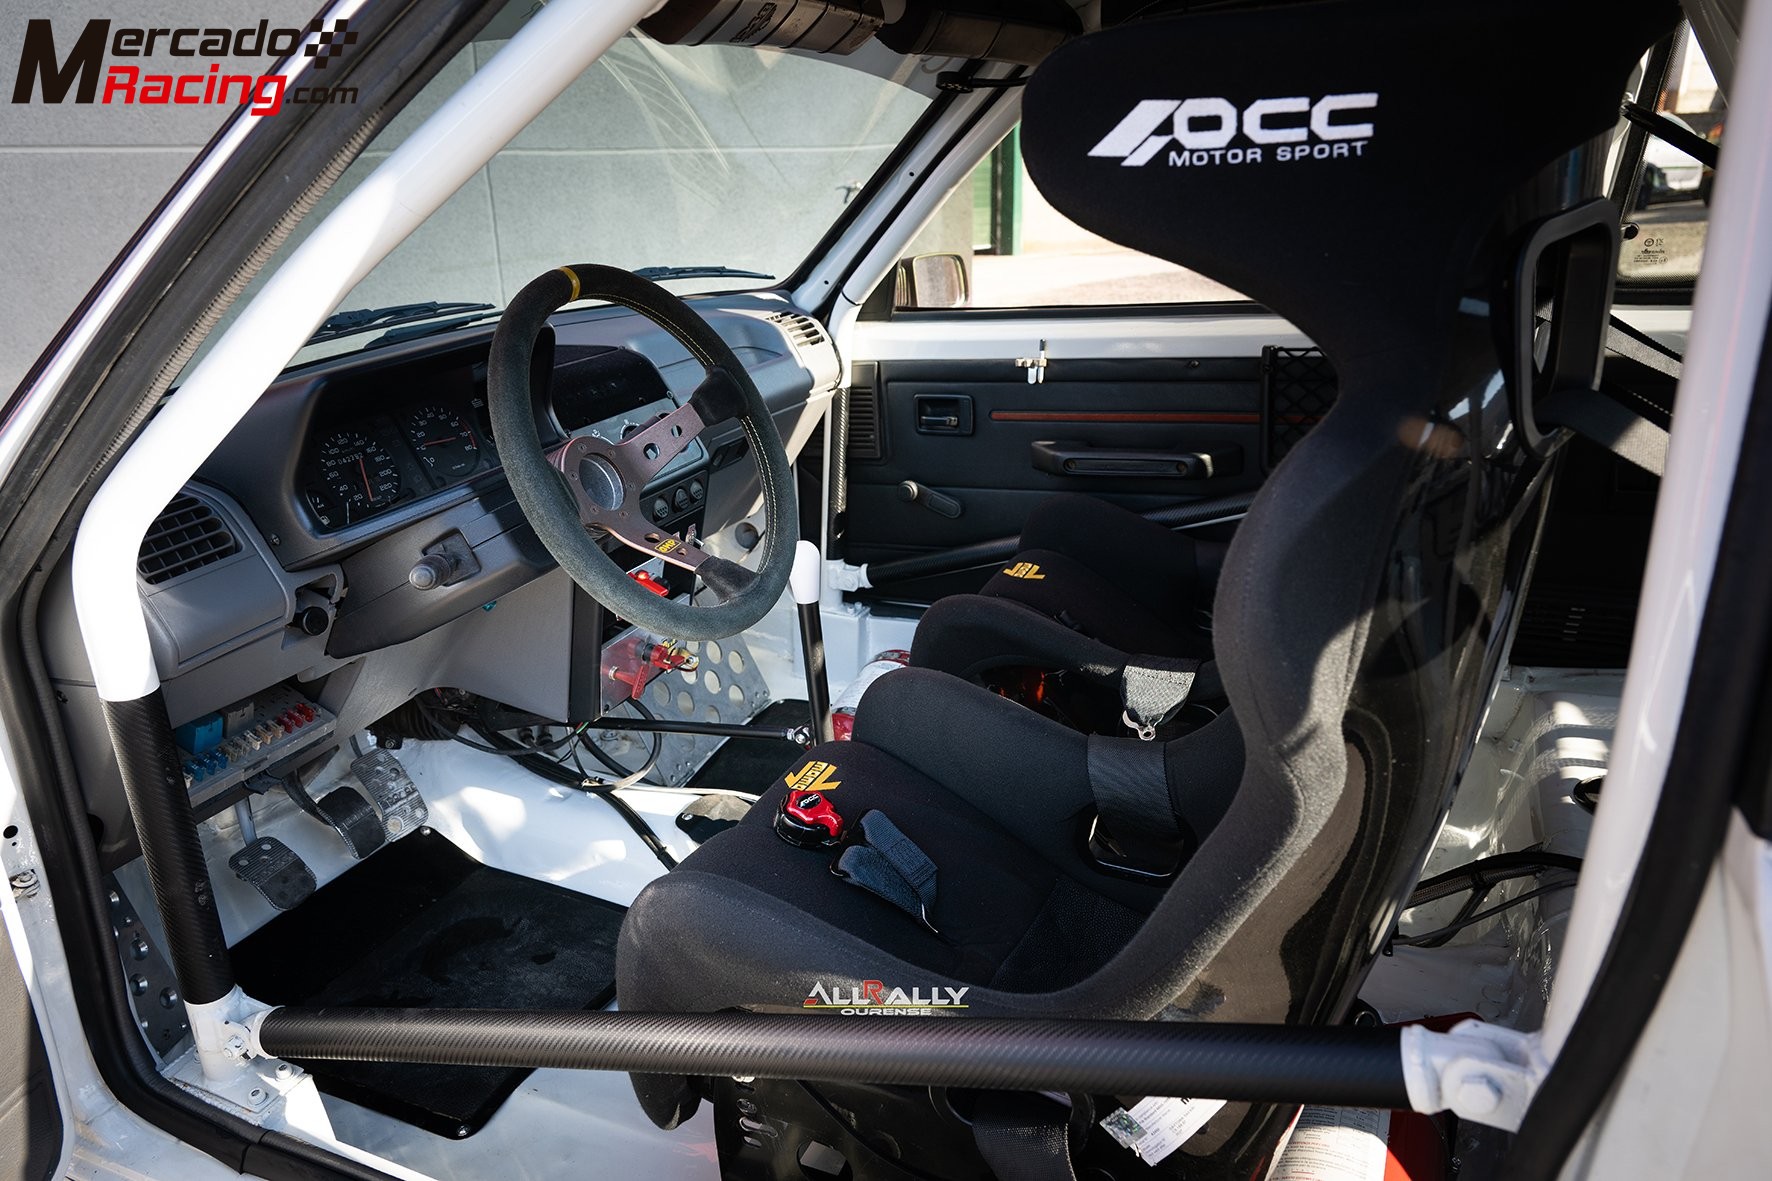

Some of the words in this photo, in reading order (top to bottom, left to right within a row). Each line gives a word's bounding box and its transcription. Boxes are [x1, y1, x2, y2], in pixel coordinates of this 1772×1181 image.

[1168, 148, 1262, 167] MOTOR
[1276, 141, 1369, 162] SPORT
[339, 484, 349, 492] 40
[657, 539, 677, 553] OMP
[803, 979, 970, 1005] ALLRALLY
[840, 1007, 932, 1016] OURENSE
